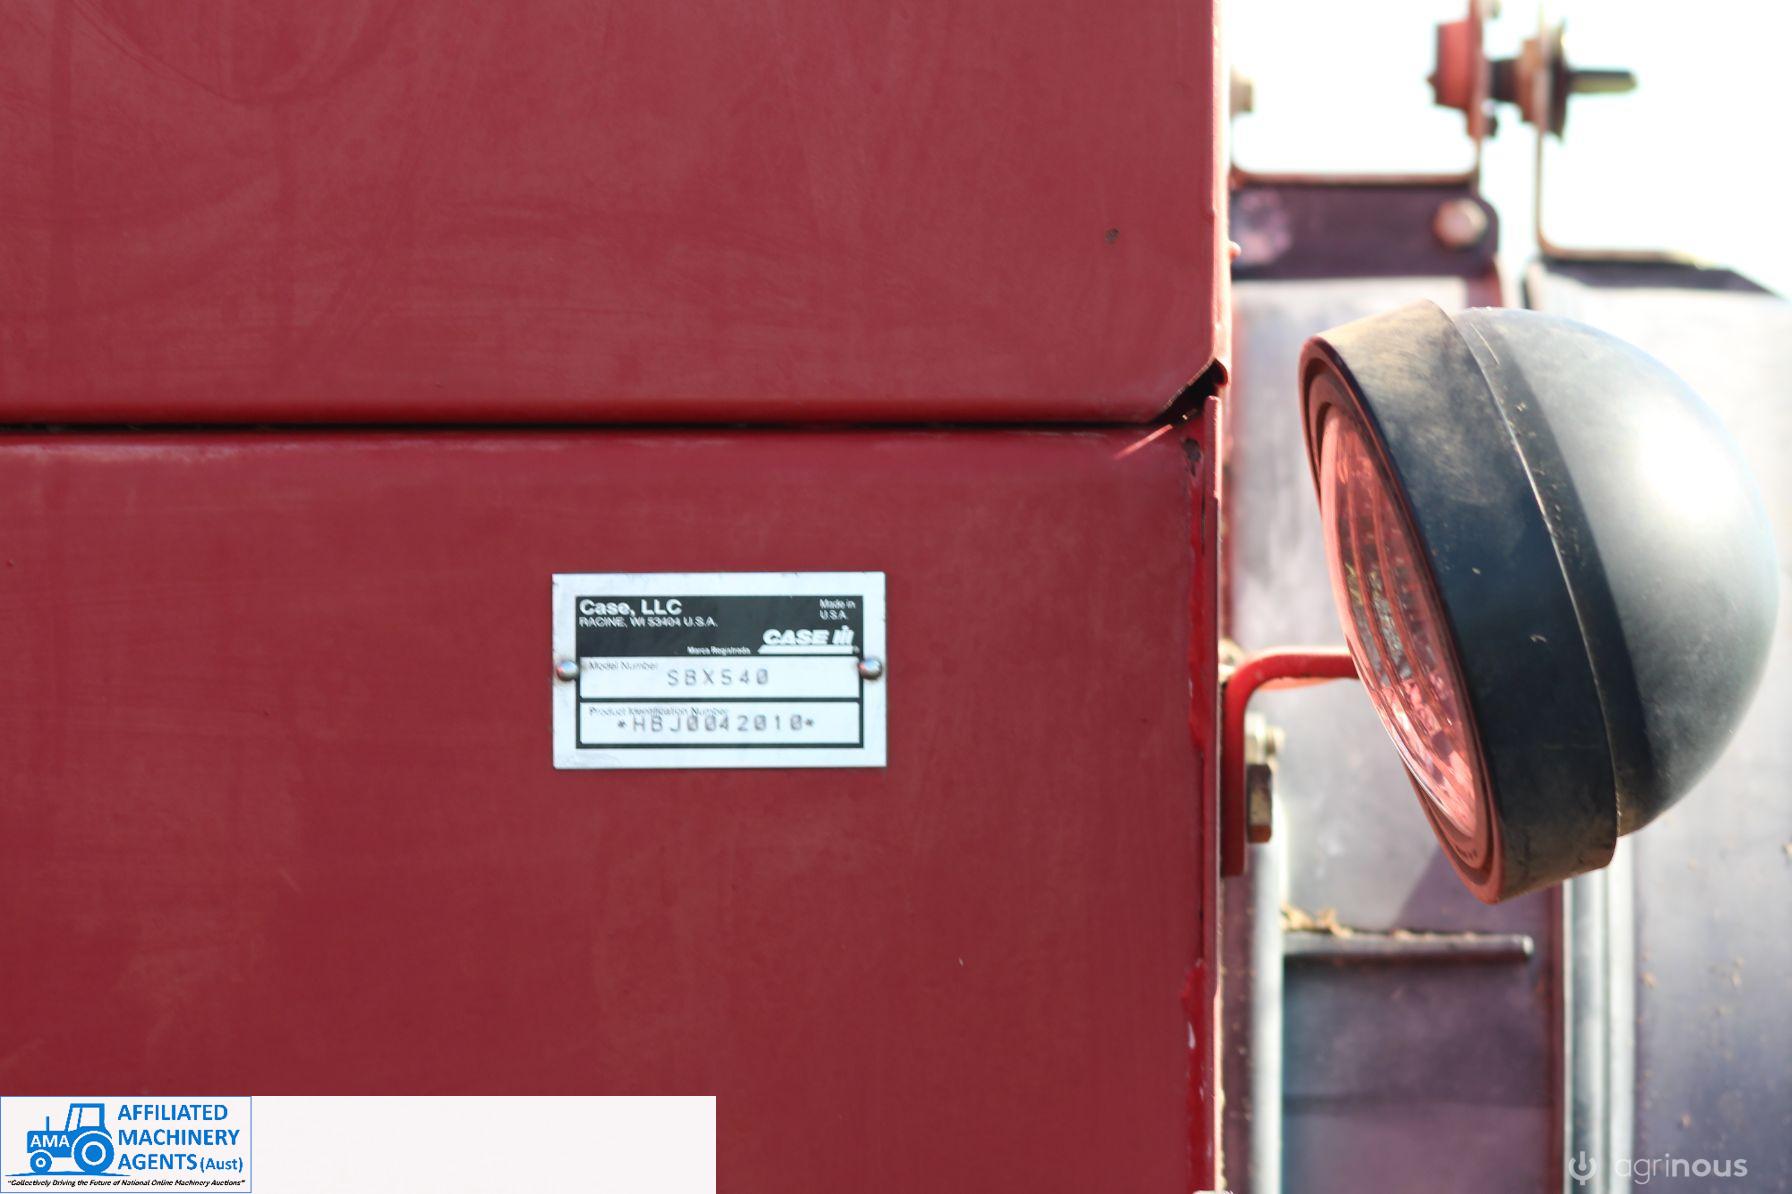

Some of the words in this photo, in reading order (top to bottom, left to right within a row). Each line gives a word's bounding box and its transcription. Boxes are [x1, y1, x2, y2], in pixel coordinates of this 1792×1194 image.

[579, 599, 635, 616] Case,
[641, 599, 682, 615] LLC
[819, 599, 845, 609] Made
[845, 599, 856, 609] in
[579, 617, 627, 628] RACINE,
[630, 617, 645, 627] WI
[647, 617, 681, 627] 53404
[683, 617, 718, 628] U.S.A.
[762, 629, 829, 645] CASE
[687, 646, 710, 655] Marca
[711, 646, 750, 656] Registrada
[589, 661, 619, 670] Model
[621, 661, 658, 670] Number
[667, 669, 769, 687] SBX540
[589, 707, 626, 716] Product
[628, 707, 688, 716] Identification
[691, 707, 728, 716] Number
